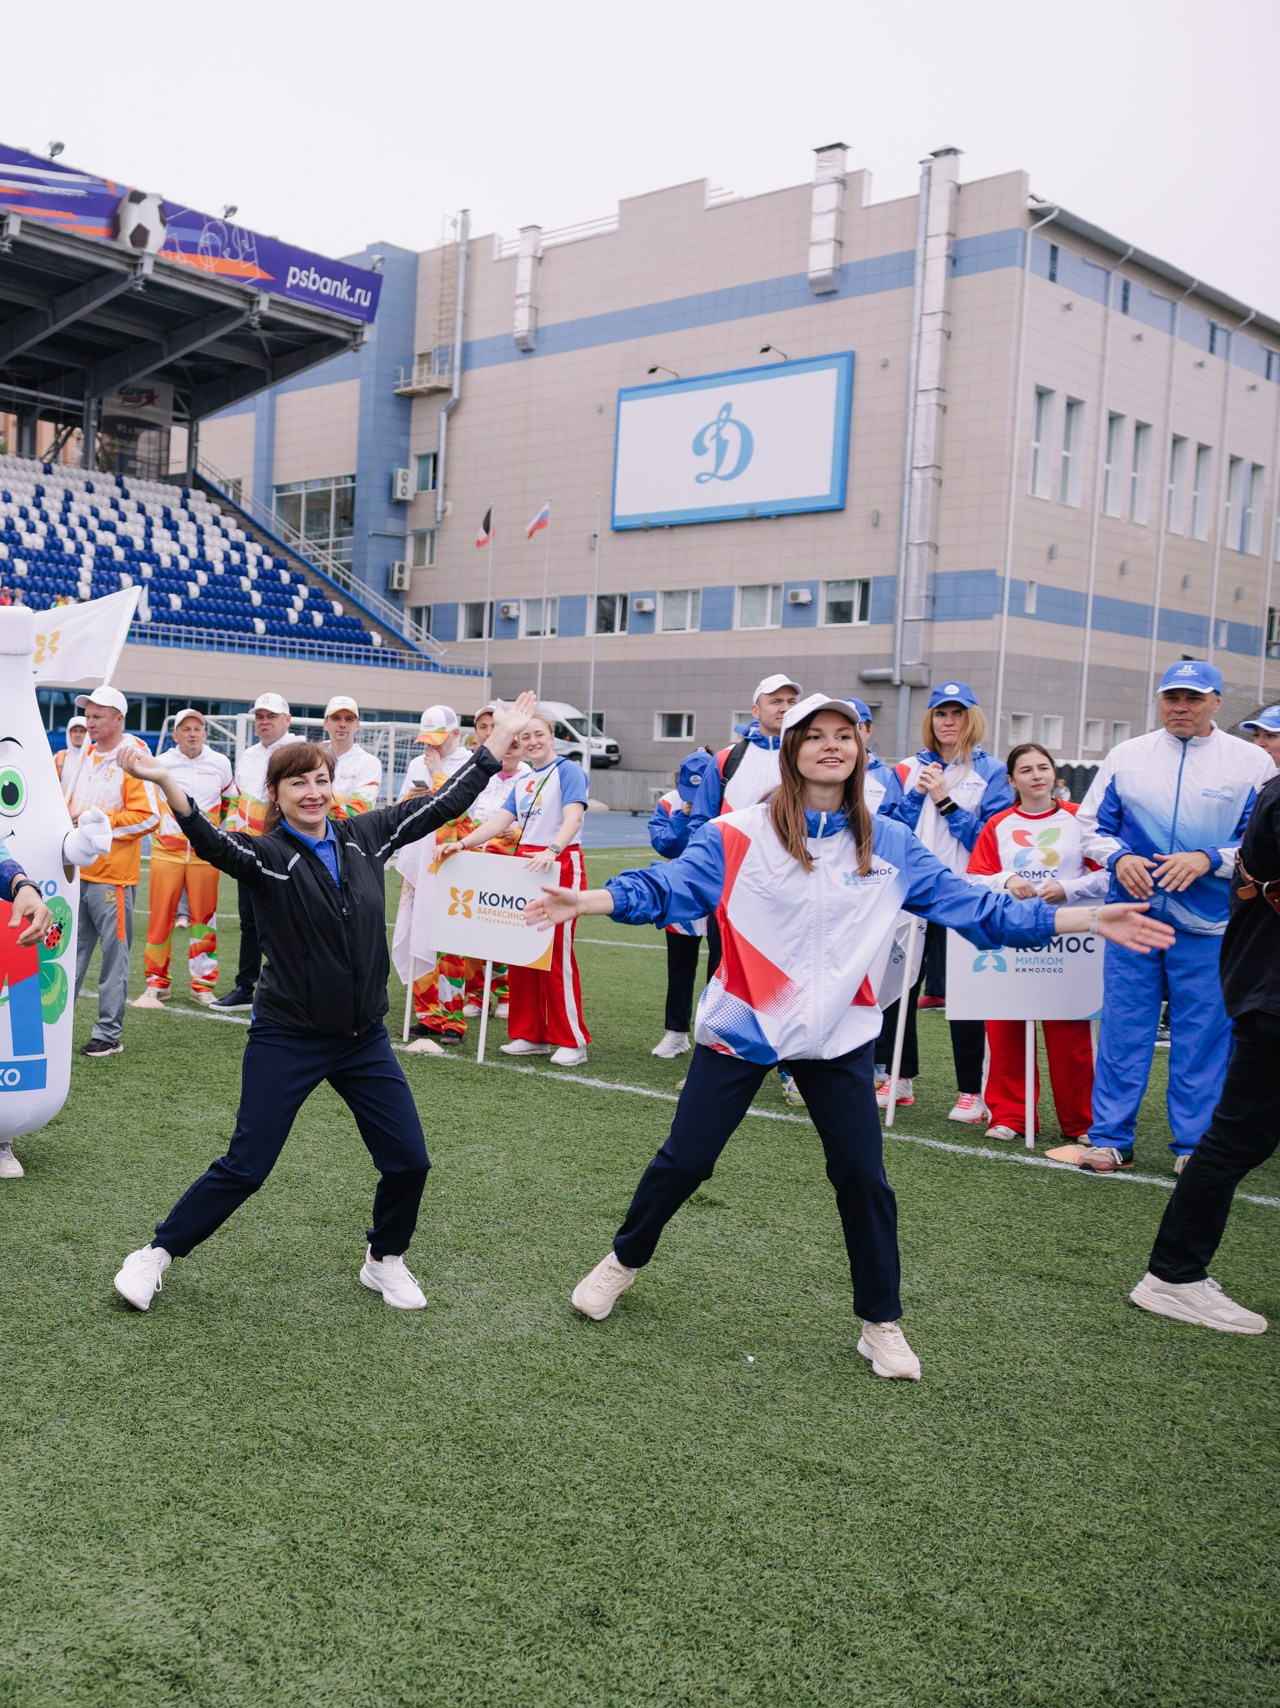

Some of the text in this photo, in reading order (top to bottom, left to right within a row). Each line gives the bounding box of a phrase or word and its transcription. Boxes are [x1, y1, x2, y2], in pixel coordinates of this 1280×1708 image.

[286, 266, 372, 307] psbank.ru
[479, 891, 536, 911] КОМО
[477, 906, 526, 921] ВАРАКСИНО
[1015, 956, 1064, 966] МИЛКОМ
